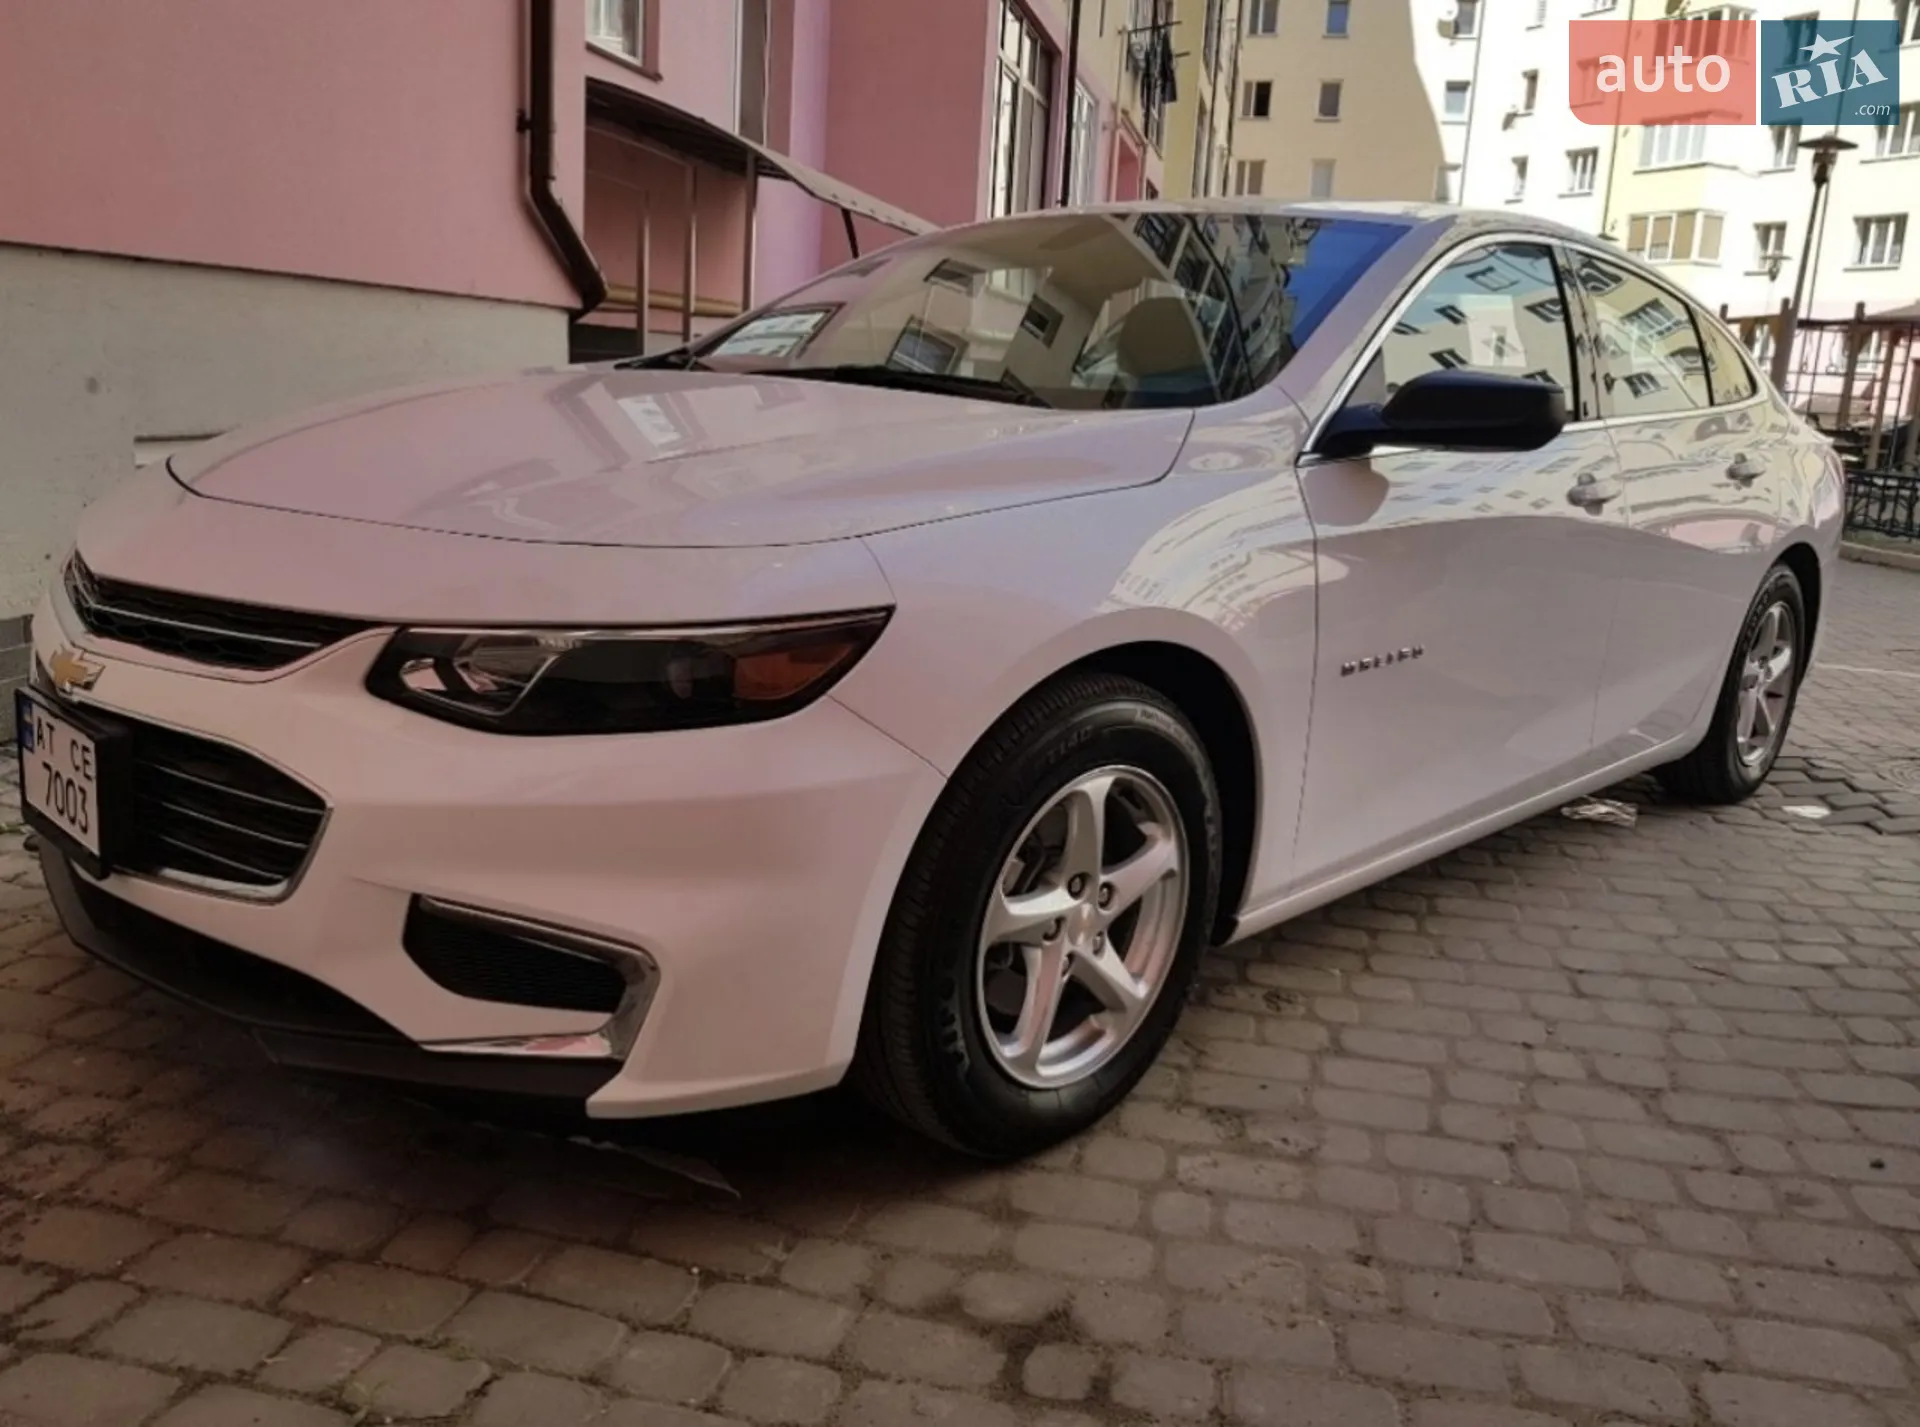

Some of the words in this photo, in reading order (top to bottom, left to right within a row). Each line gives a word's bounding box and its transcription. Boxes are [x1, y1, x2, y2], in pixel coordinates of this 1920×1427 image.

[37, 716, 55, 755] AT
[70, 738, 92, 781] CE
[42, 761, 88, 834] 7003
